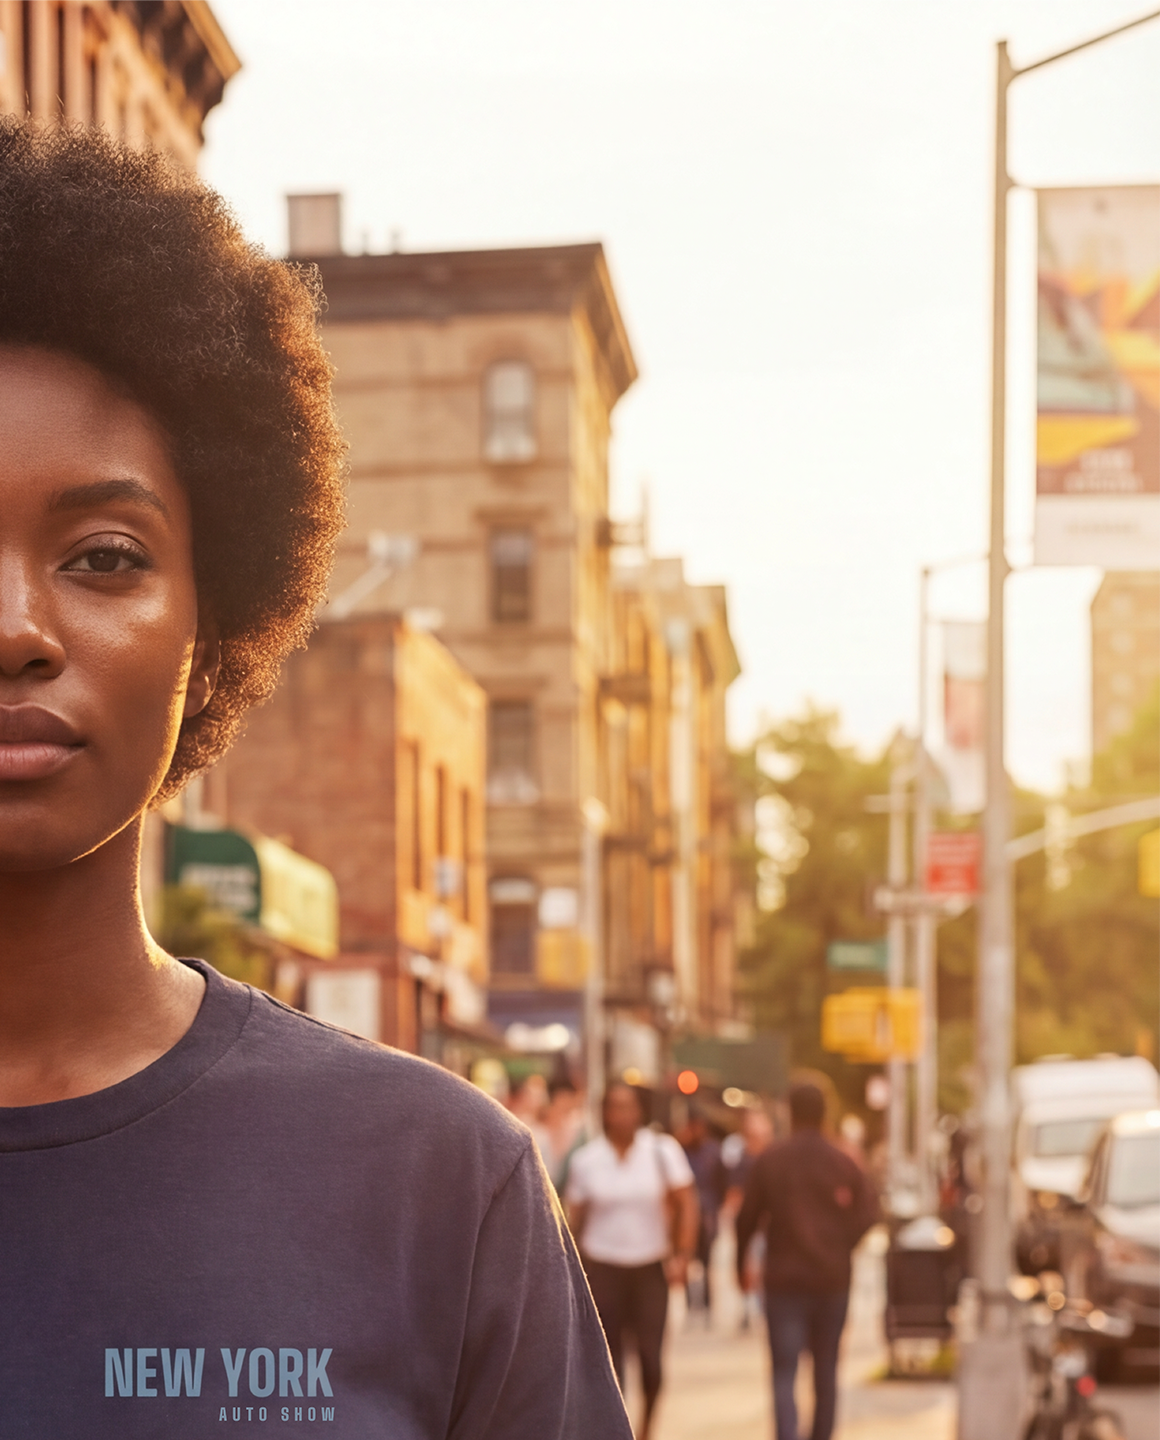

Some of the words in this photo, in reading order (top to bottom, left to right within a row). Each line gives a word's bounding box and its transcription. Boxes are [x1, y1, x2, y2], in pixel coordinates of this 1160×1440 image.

[104, 1347, 206, 1398] NEW
[220, 1347, 334, 1398] YORK
[218, 1406, 268, 1422] AUTO
[280, 1406, 336, 1422] SHOW
